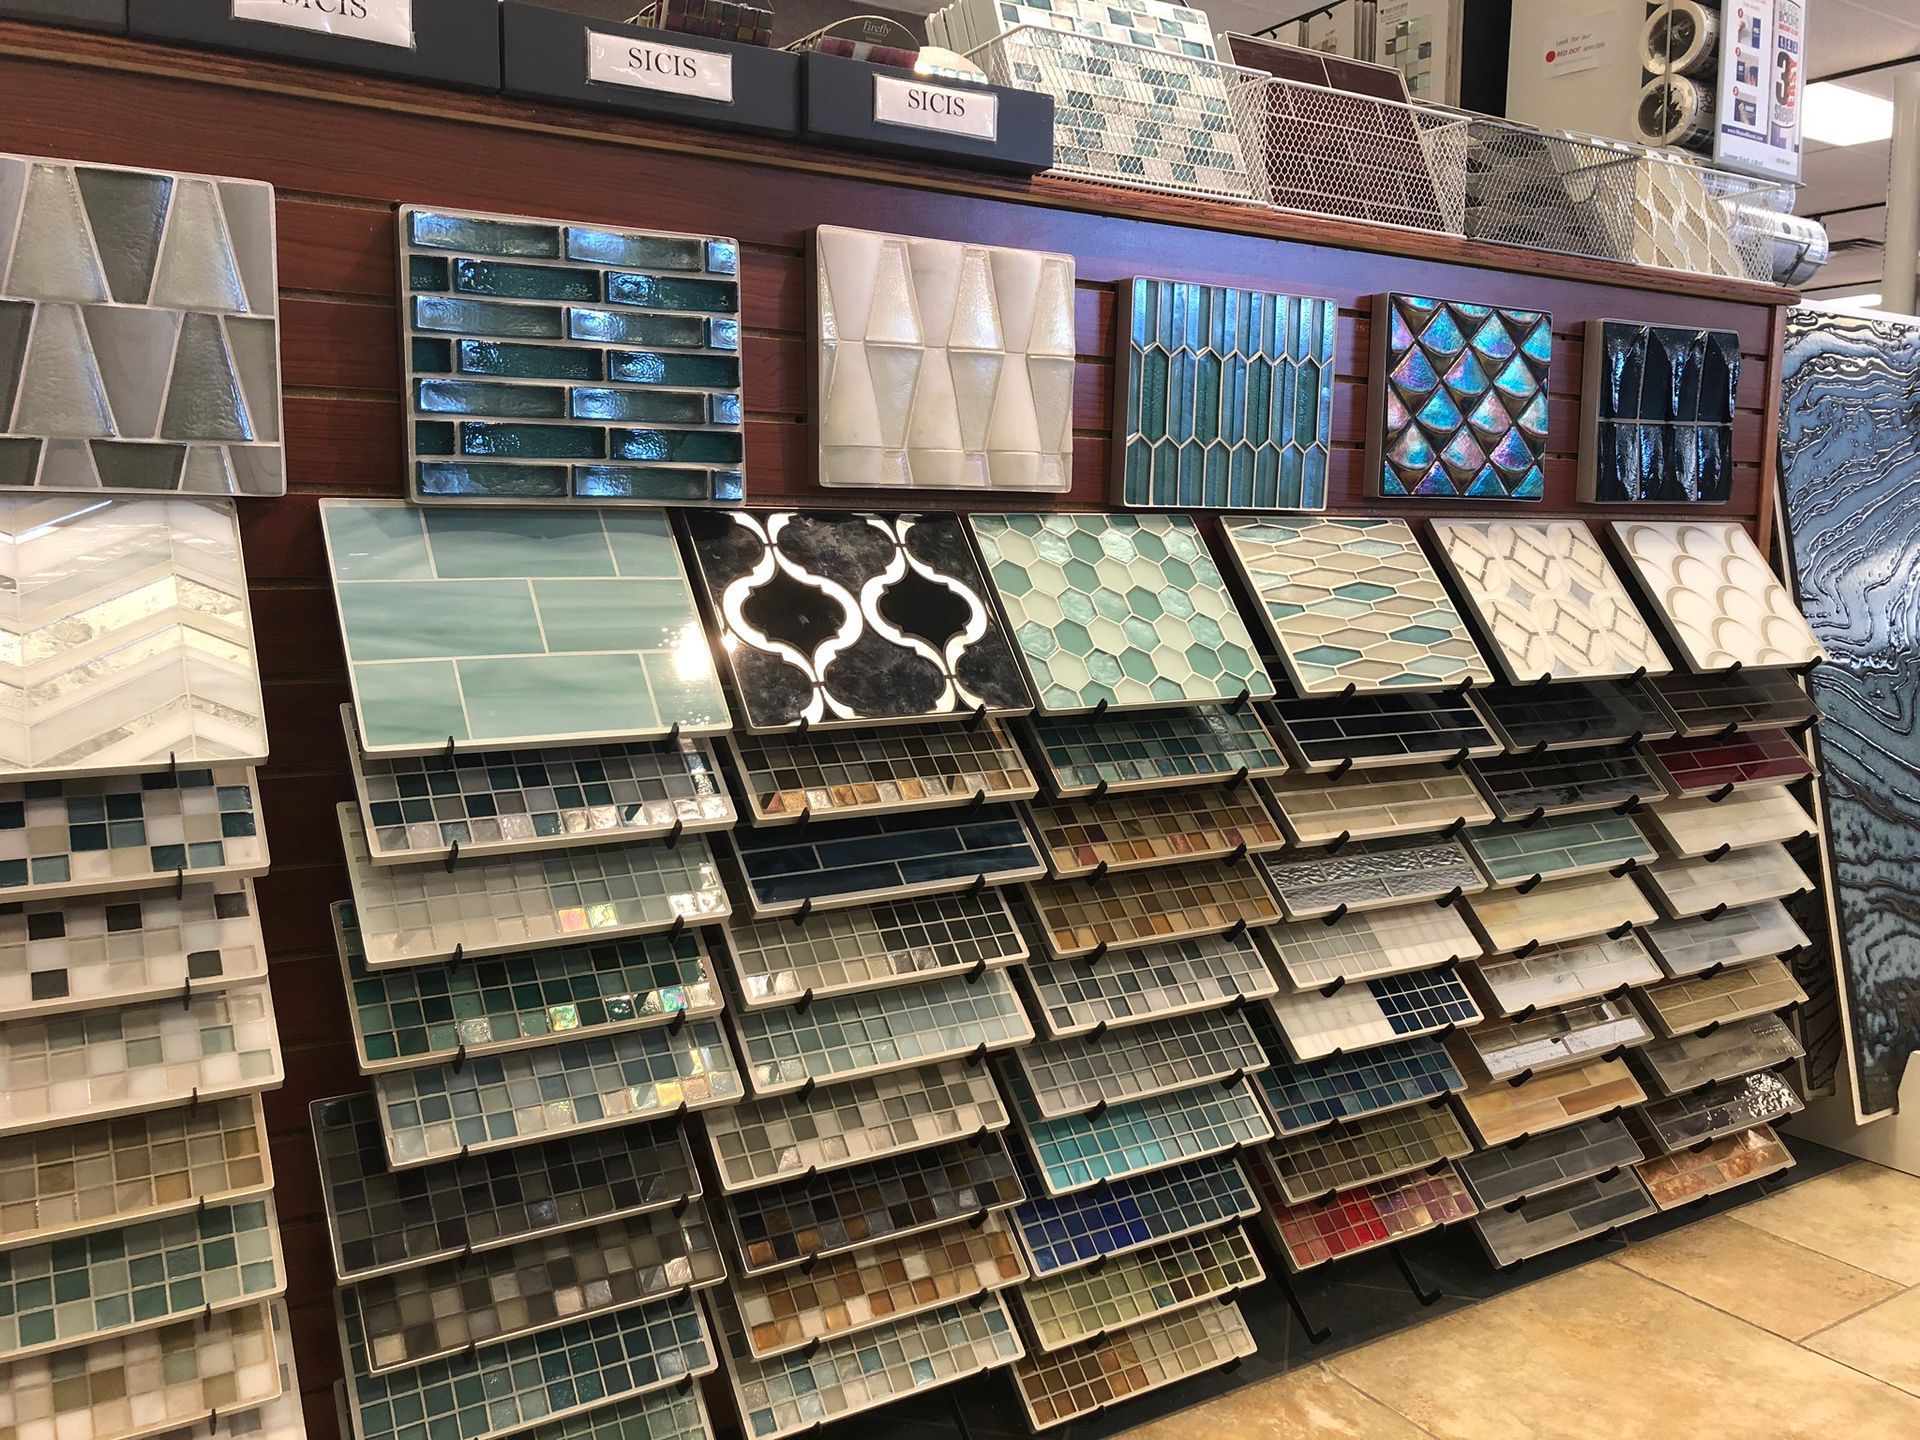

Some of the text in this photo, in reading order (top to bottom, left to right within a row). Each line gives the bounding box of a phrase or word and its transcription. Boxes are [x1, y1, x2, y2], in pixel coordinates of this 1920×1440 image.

[863, 20, 891, 36] Firefly
[628, 47, 697, 79] SICIS
[1776, 51, 1790, 105] 3
[908, 89, 965, 117] SICIS
